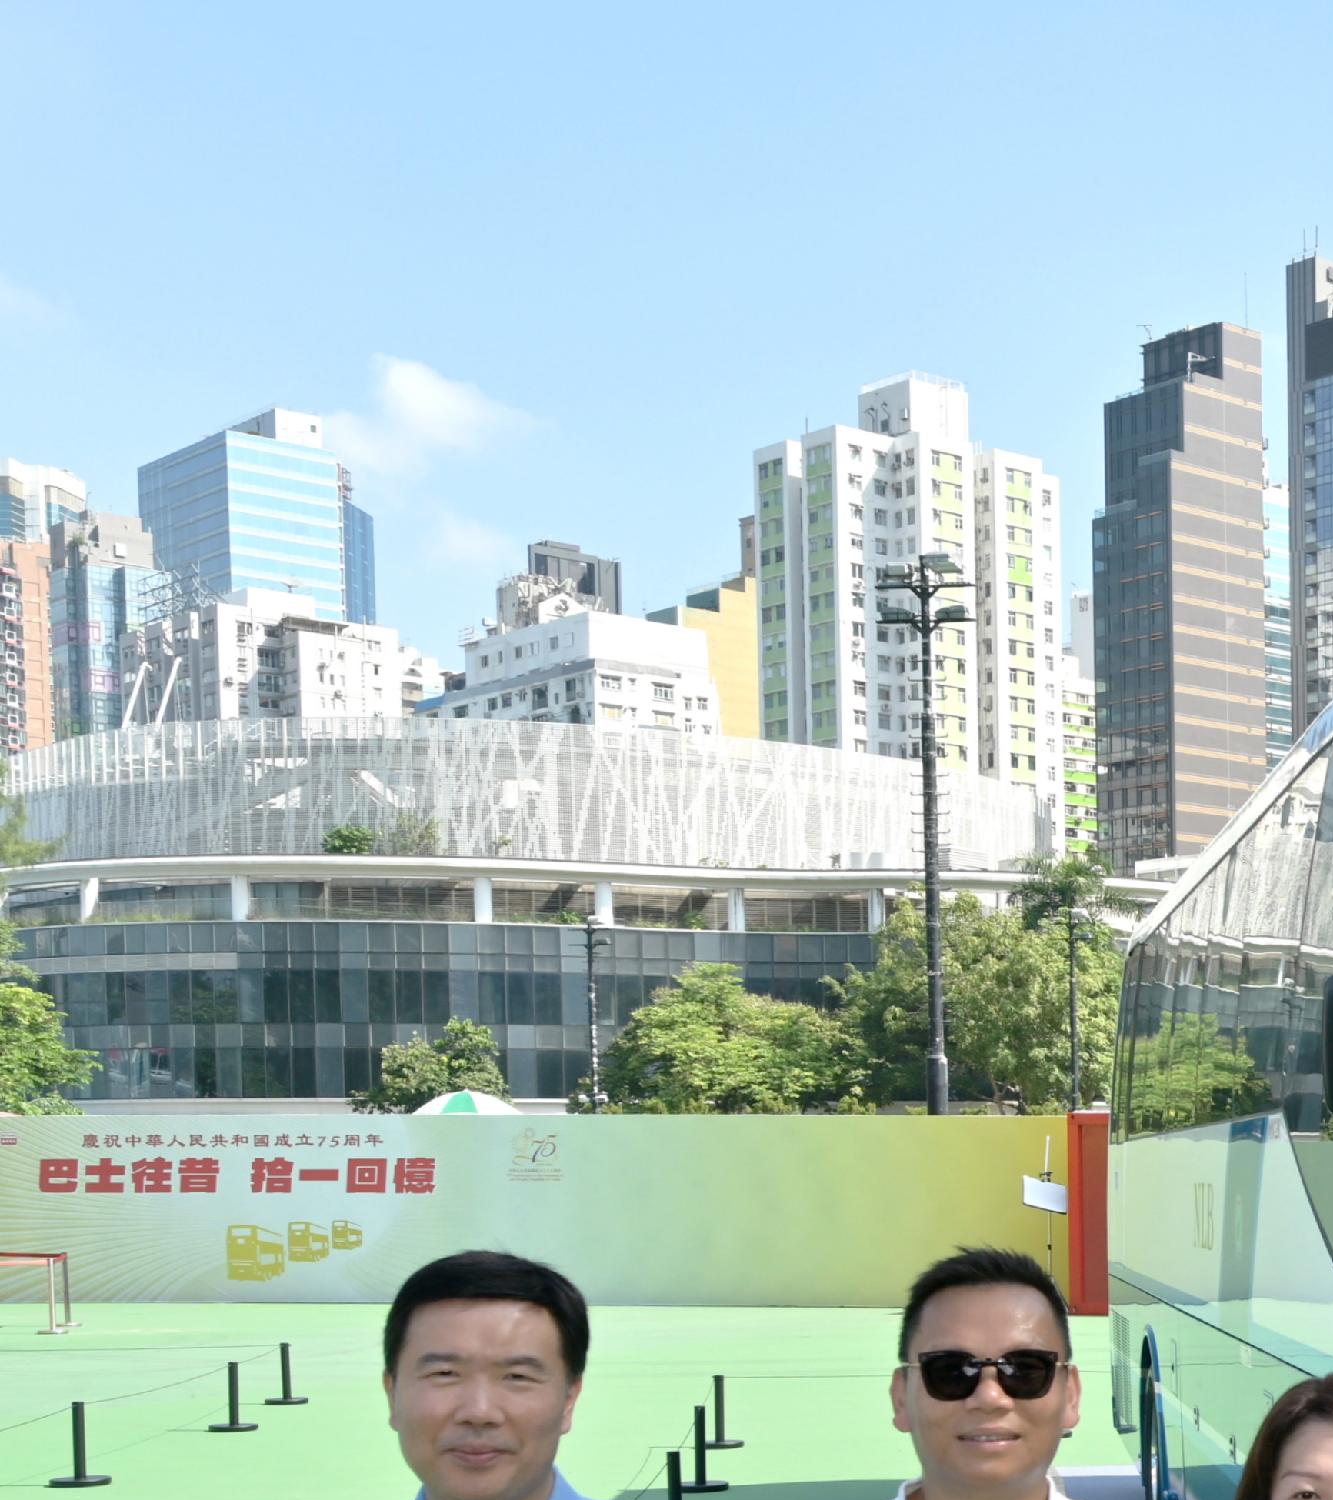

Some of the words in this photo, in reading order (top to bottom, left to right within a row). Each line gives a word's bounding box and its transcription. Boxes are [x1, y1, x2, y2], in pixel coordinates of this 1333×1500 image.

[81, 1133, 384, 1149] 慶祝中華人民共和國成立75周年
[39, 1156, 220, 1194] 巴士往昔
[250, 1156, 436, 1194] 拾一回憶
[1194, 1182, 1215, 1251] NLB
